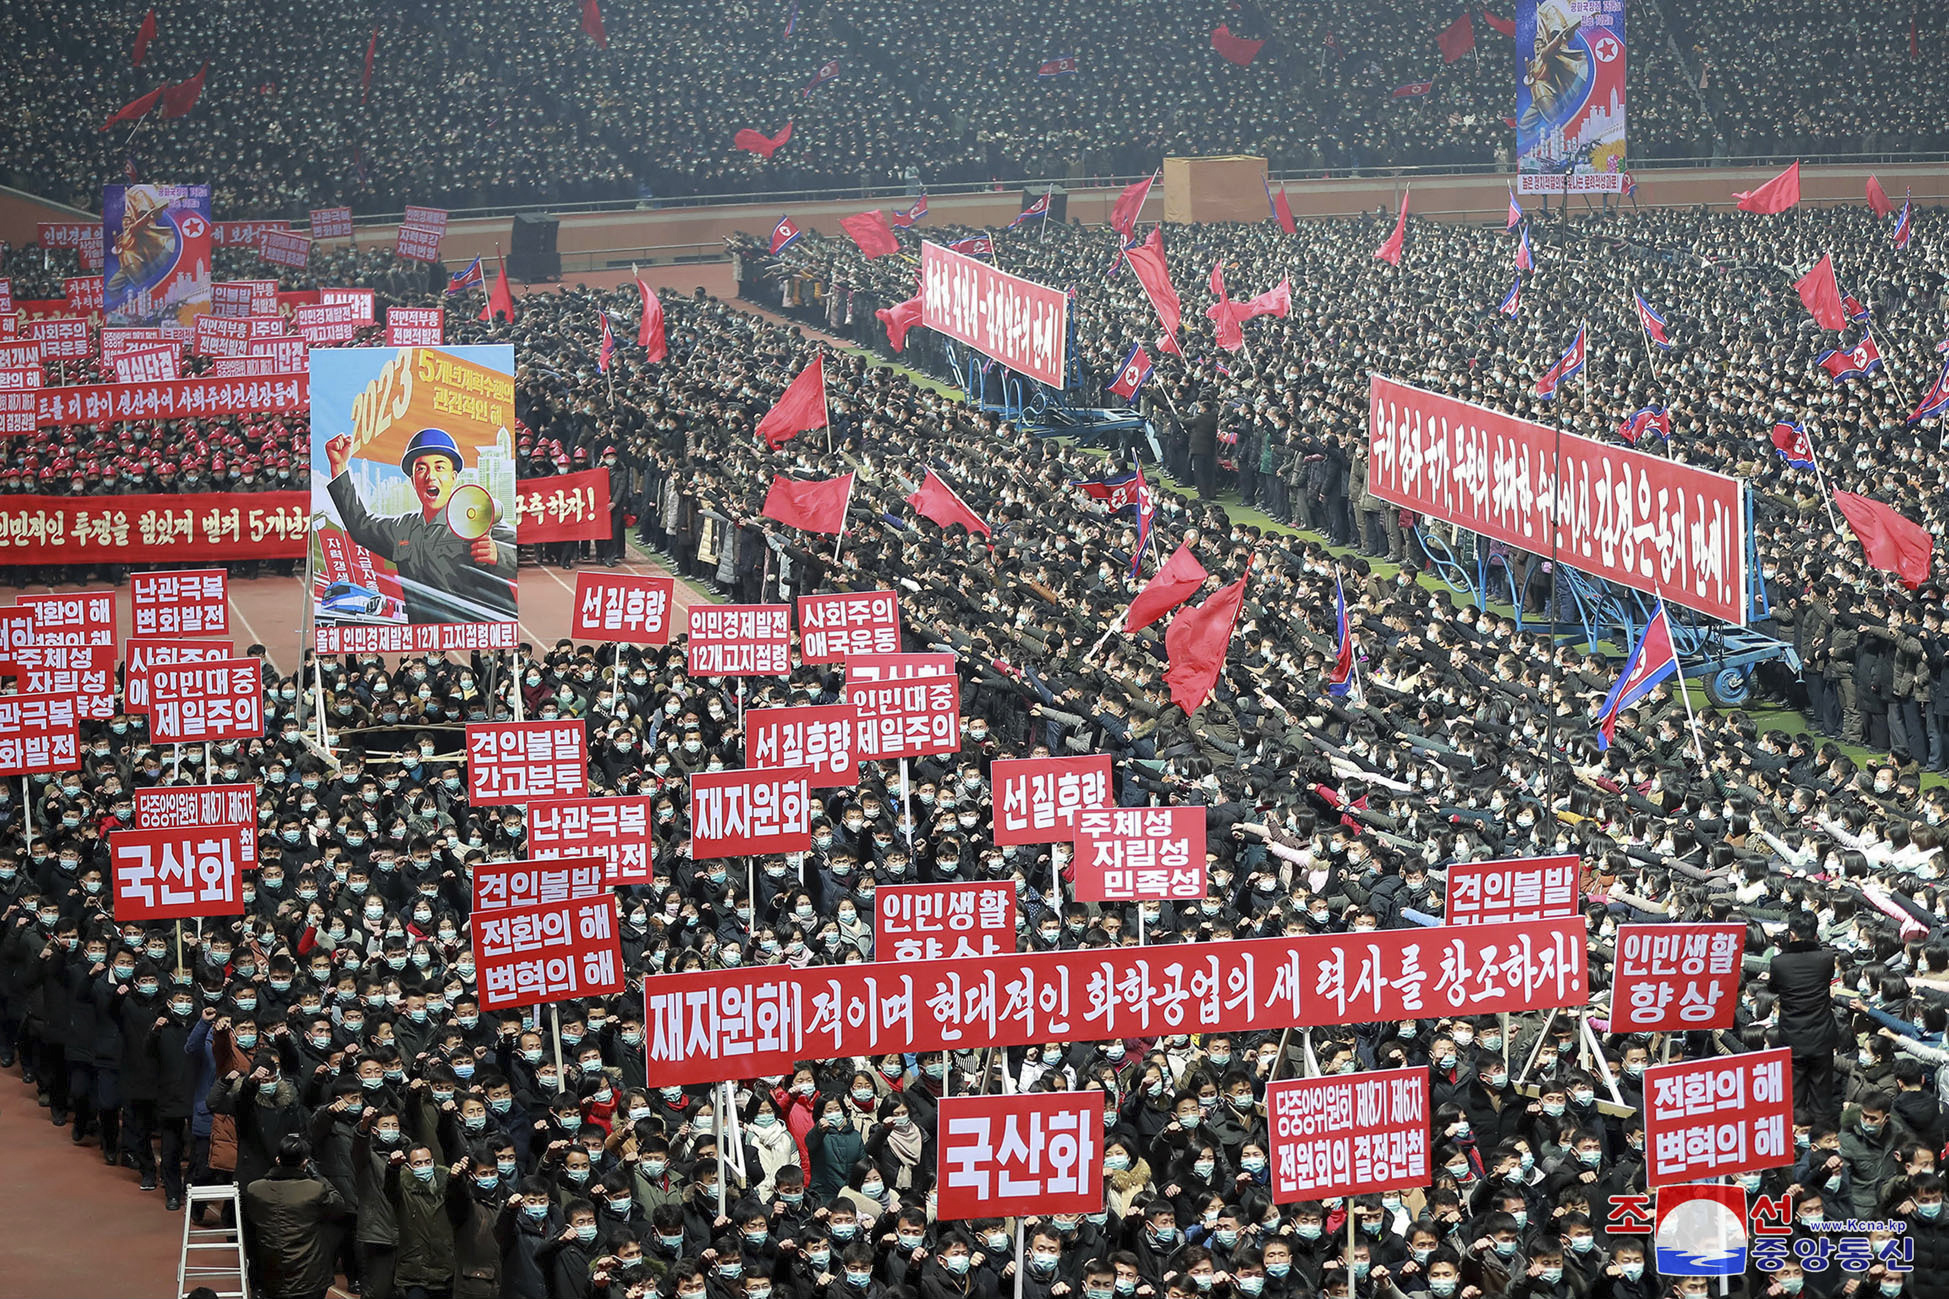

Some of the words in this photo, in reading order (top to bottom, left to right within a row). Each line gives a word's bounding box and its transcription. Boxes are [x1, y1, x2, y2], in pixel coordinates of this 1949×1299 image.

[211, 286, 252, 303] 인불발
[33, 321, 87, 341] 사회주의
[250, 320, 284, 337] 주의
[392, 327, 441, 345] 전면적발전
[926, 256, 951, 327] 위대한
[1032, 300, 1059, 376] 만세!
[418, 348, 515, 405] 5개년계획수행의
[68, 392, 82, 420] 더
[86, 390, 114, 420] 많이
[116, 386, 174, 416] 생산하여
[177, 379, 300, 414] 사회주의건설장들에
[350, 348, 413, 452] 2023
[433, 385, 489, 424] 관건적인
[490, 405, 504, 427] 해
[1373, 397, 1397, 492] 우리
[1399, 406, 1424, 500] 당과
[1424, 414, 1453, 519] 국가,
[1453, 423, 1490, 524] 무력의
[1492, 433, 1535, 538] 위대한
[1690, 492, 1732, 606] 만세!
[70, 508, 131, 548] 투쟁을
[138, 508, 194, 546] 힘있게
[202, 506, 241, 544] 벌려
[134, 575, 225, 604] 난관극복
[581, 585, 667, 634] 선질후량
[89, 598, 111, 624] 해
[136, 604, 226, 635] 변화발전
[691, 609, 788, 640] 인민경제발전
[803, 597, 895, 629] 사회주의
[316, 629, 340, 653] 올해
[343, 626, 413, 652] 인민경제발전
[416, 624, 440, 650] 12개
[442, 622, 519, 649] 고지점령에로!
[692, 643, 789, 673] 12개고지점령
[805, 625, 897, 659] 애국운동
[17, 647, 93, 670] 주체성
[26, 670, 107, 693] 자립성
[154, 666, 257, 700] 인민대중
[853, 682, 954, 717] 인민대중
[154, 696, 259, 737] 제일주의
[856, 713, 956, 755] 제일주의
[0, 733, 77, 769] 화발전
[471, 728, 581, 765] 견인불발
[755, 719, 851, 774] 선질후량
[474, 763, 583, 798] 간고분투
[140, 793, 199, 828] 당중앙위원회
[200, 790, 226, 825] 제8기
[228, 790, 253, 823] 제6차
[533, 803, 647, 841] 난관극복
[695, 779, 812, 840] 재자원화
[1080, 810, 1173, 839] 주체성
[240, 827, 255, 862] 철
[1092, 837, 1190, 868] 자립성
[117, 838, 236, 908] 국산화
[478, 865, 602, 910] 견인불발
[1104, 867, 1201, 898] 민족성
[1452, 866, 1574, 912] 견인불발
[480, 909, 573, 957] 전환의
[578, 903, 611, 942] 해
[882, 889, 1010, 934] 인민생활
[1623, 932, 1738, 977] 인민생활
[485, 954, 578, 1004] 변혁의
[583, 948, 616, 986] 해
[926, 964, 1071, 1042] 현대적인
[1083, 949, 1256, 1030] 화학공업의
[1265, 949, 1301, 1020] 새
[1314, 940, 1428, 1017] 력사를
[1433, 930, 1581, 1007] 창조하자!
[650, 981, 791, 1063] 재자원화
[1630, 979, 1725, 1024] 향상
[1276, 1085, 1353, 1138] 당중앙위원회
[1355, 1081, 1388, 1130] 제8기
[1390, 1074, 1423, 1126] 제6차
[1653, 1071, 1745, 1122] 전환의
[1752, 1060, 1784, 1103] 해
[945, 1109, 1095, 1201] 국산화
[1277, 1136, 1351, 1193] 전원회의
[1353, 1127, 1425, 1185] 결정관철
[1655, 1120, 1747, 1175] 변혁의
[1754, 1114, 1785, 1157] 해
